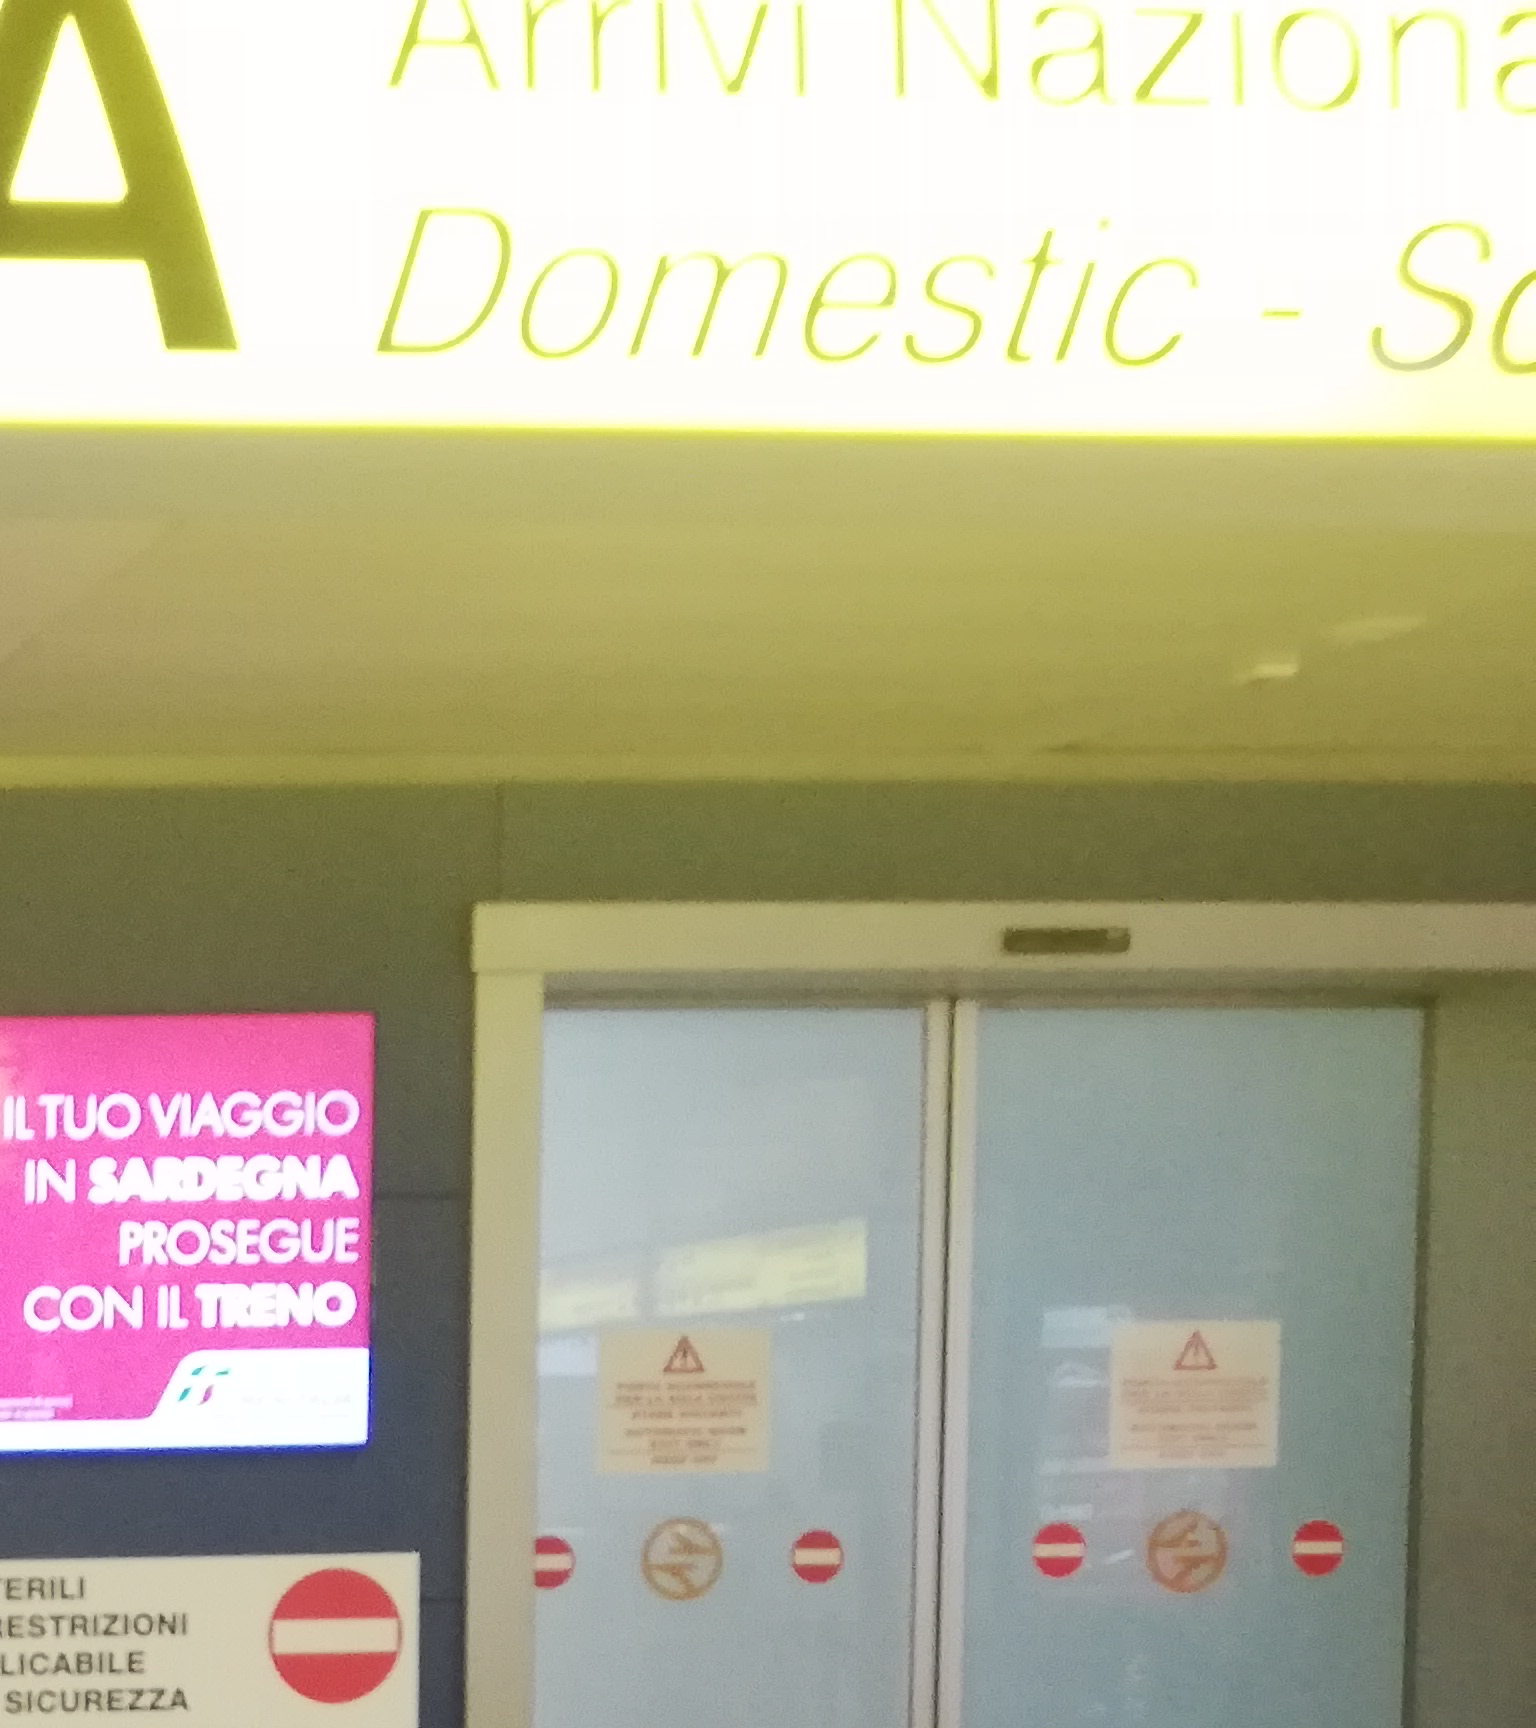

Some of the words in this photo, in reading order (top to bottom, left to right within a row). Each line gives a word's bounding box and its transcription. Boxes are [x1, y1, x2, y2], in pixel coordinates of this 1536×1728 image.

[378, 208, 1199, 366] Domestic
[3, 1095, 35, 1140] IL
[38, 1092, 141, 1140] TUO
[149, 1089, 359, 1138] VIAGGIO
[25, 1158, 76, 1204] IN
[87, 1154, 359, 1204] SARDEGNA
[119, 1217, 360, 1267] PROSEGUE
[24, 1284, 143, 1332] CON
[158, 1284, 189, 1329] IL
[194, 1280, 357, 1329] TRENO
[5, 1687, 189, 1714] SICUREZZA
